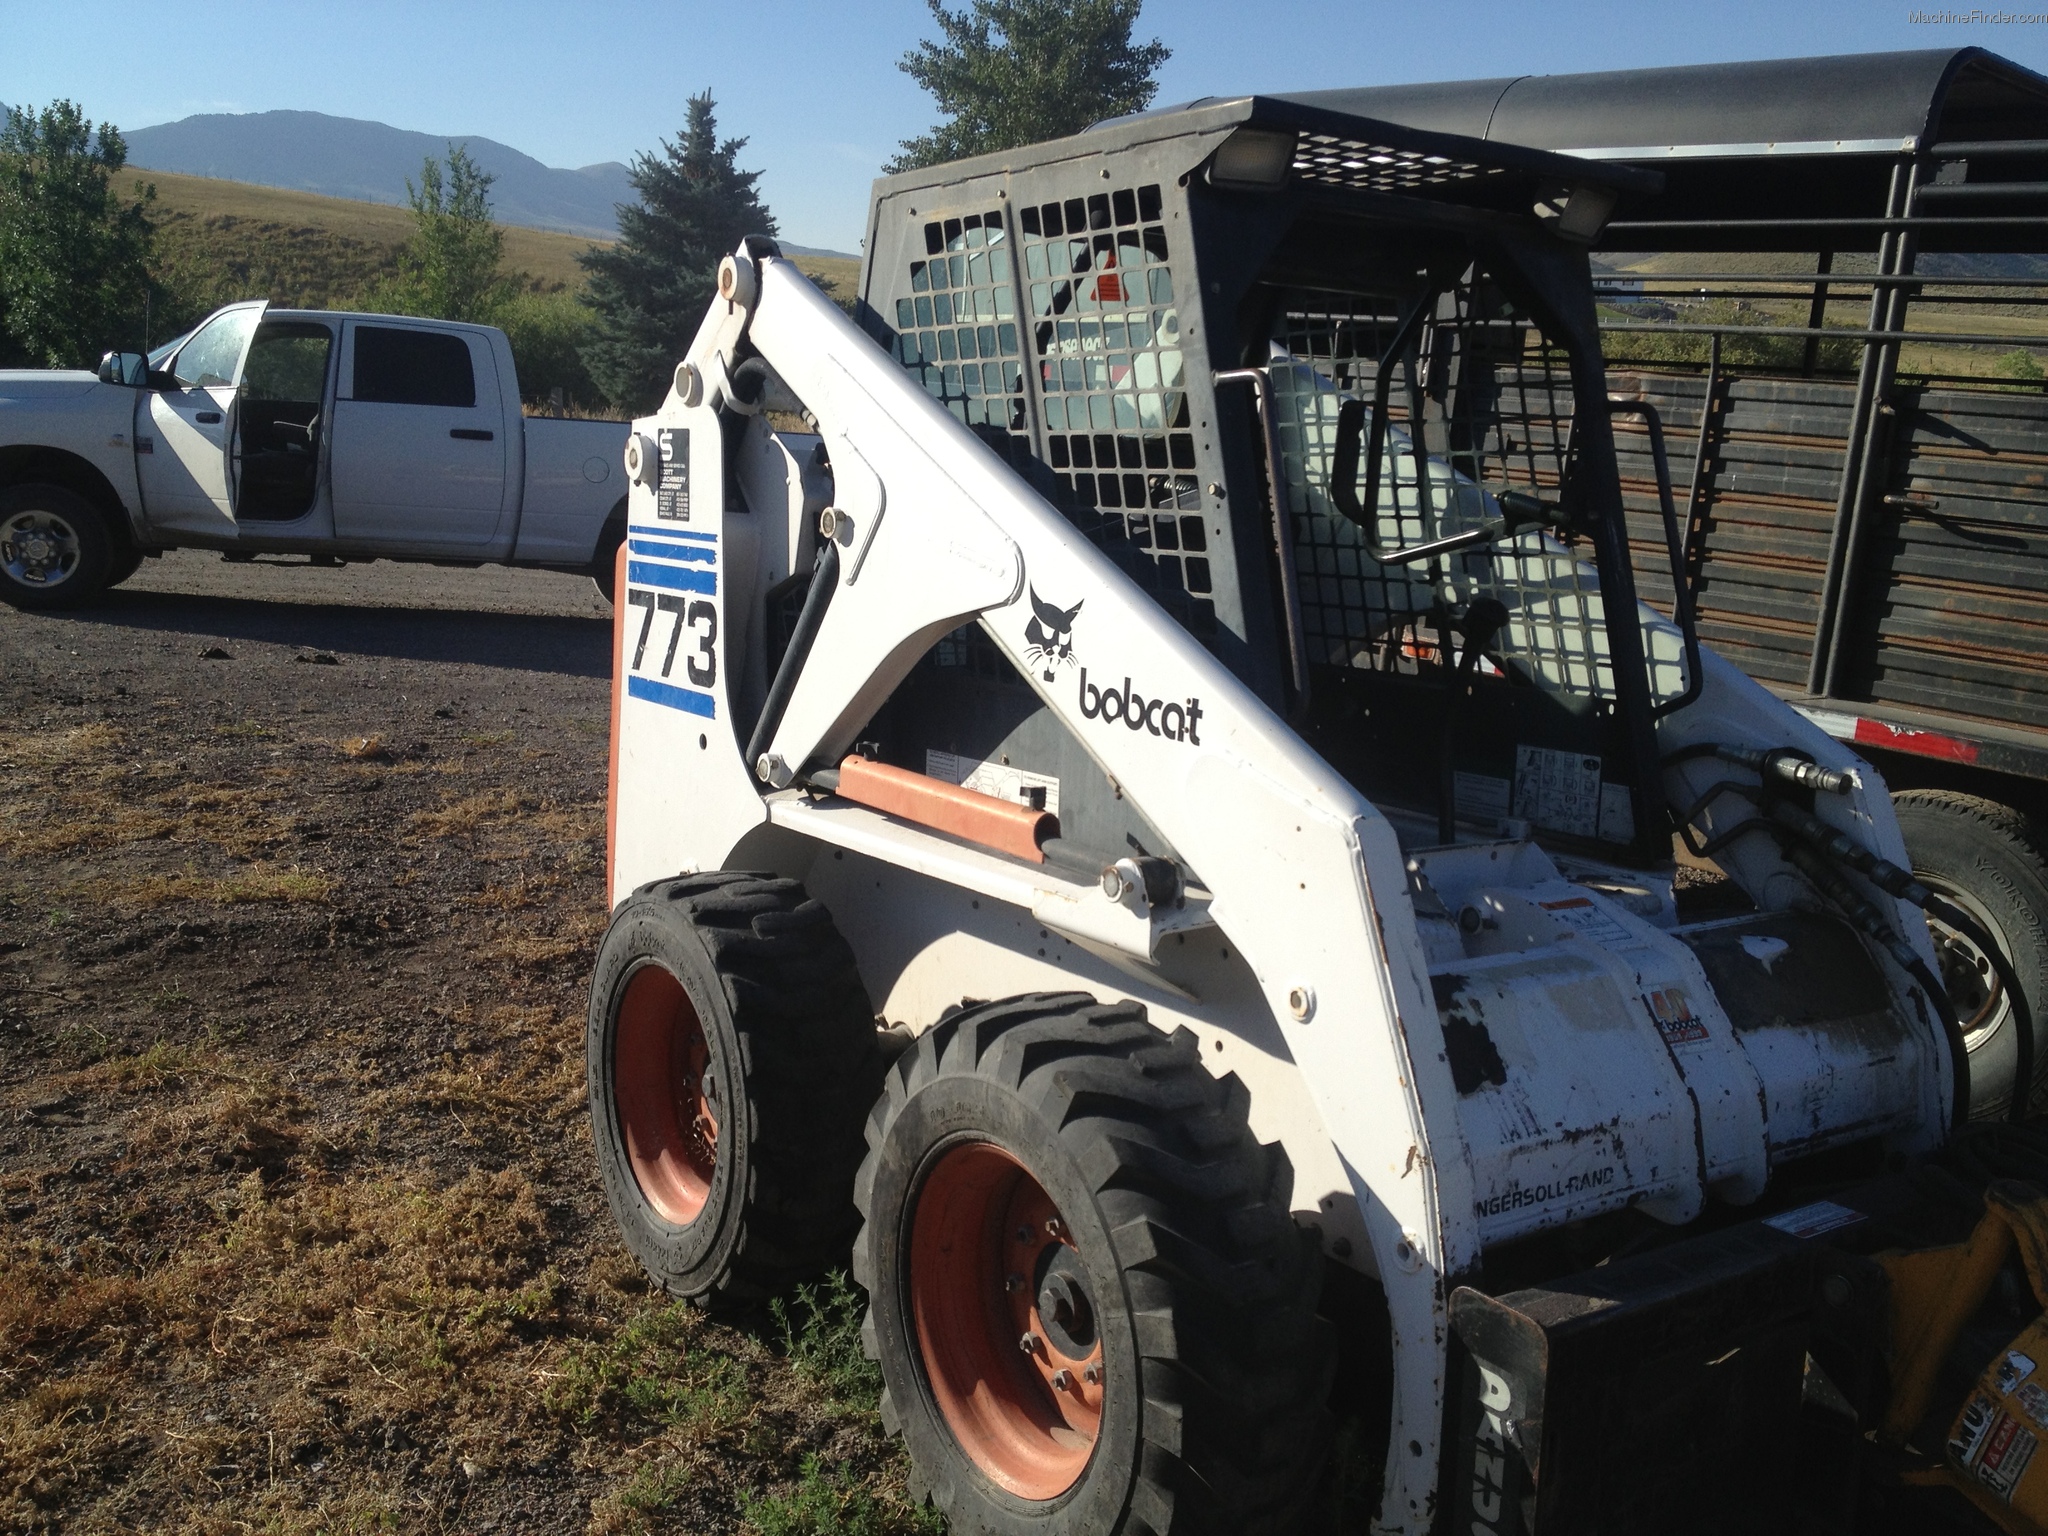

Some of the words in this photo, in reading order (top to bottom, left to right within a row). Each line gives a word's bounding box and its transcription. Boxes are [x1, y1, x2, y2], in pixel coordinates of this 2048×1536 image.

[628, 589, 717, 688] 773
[1079, 667, 1203, 746] bobcat
[1476, 1166, 1614, 1218] NGERSOLL-RAND
